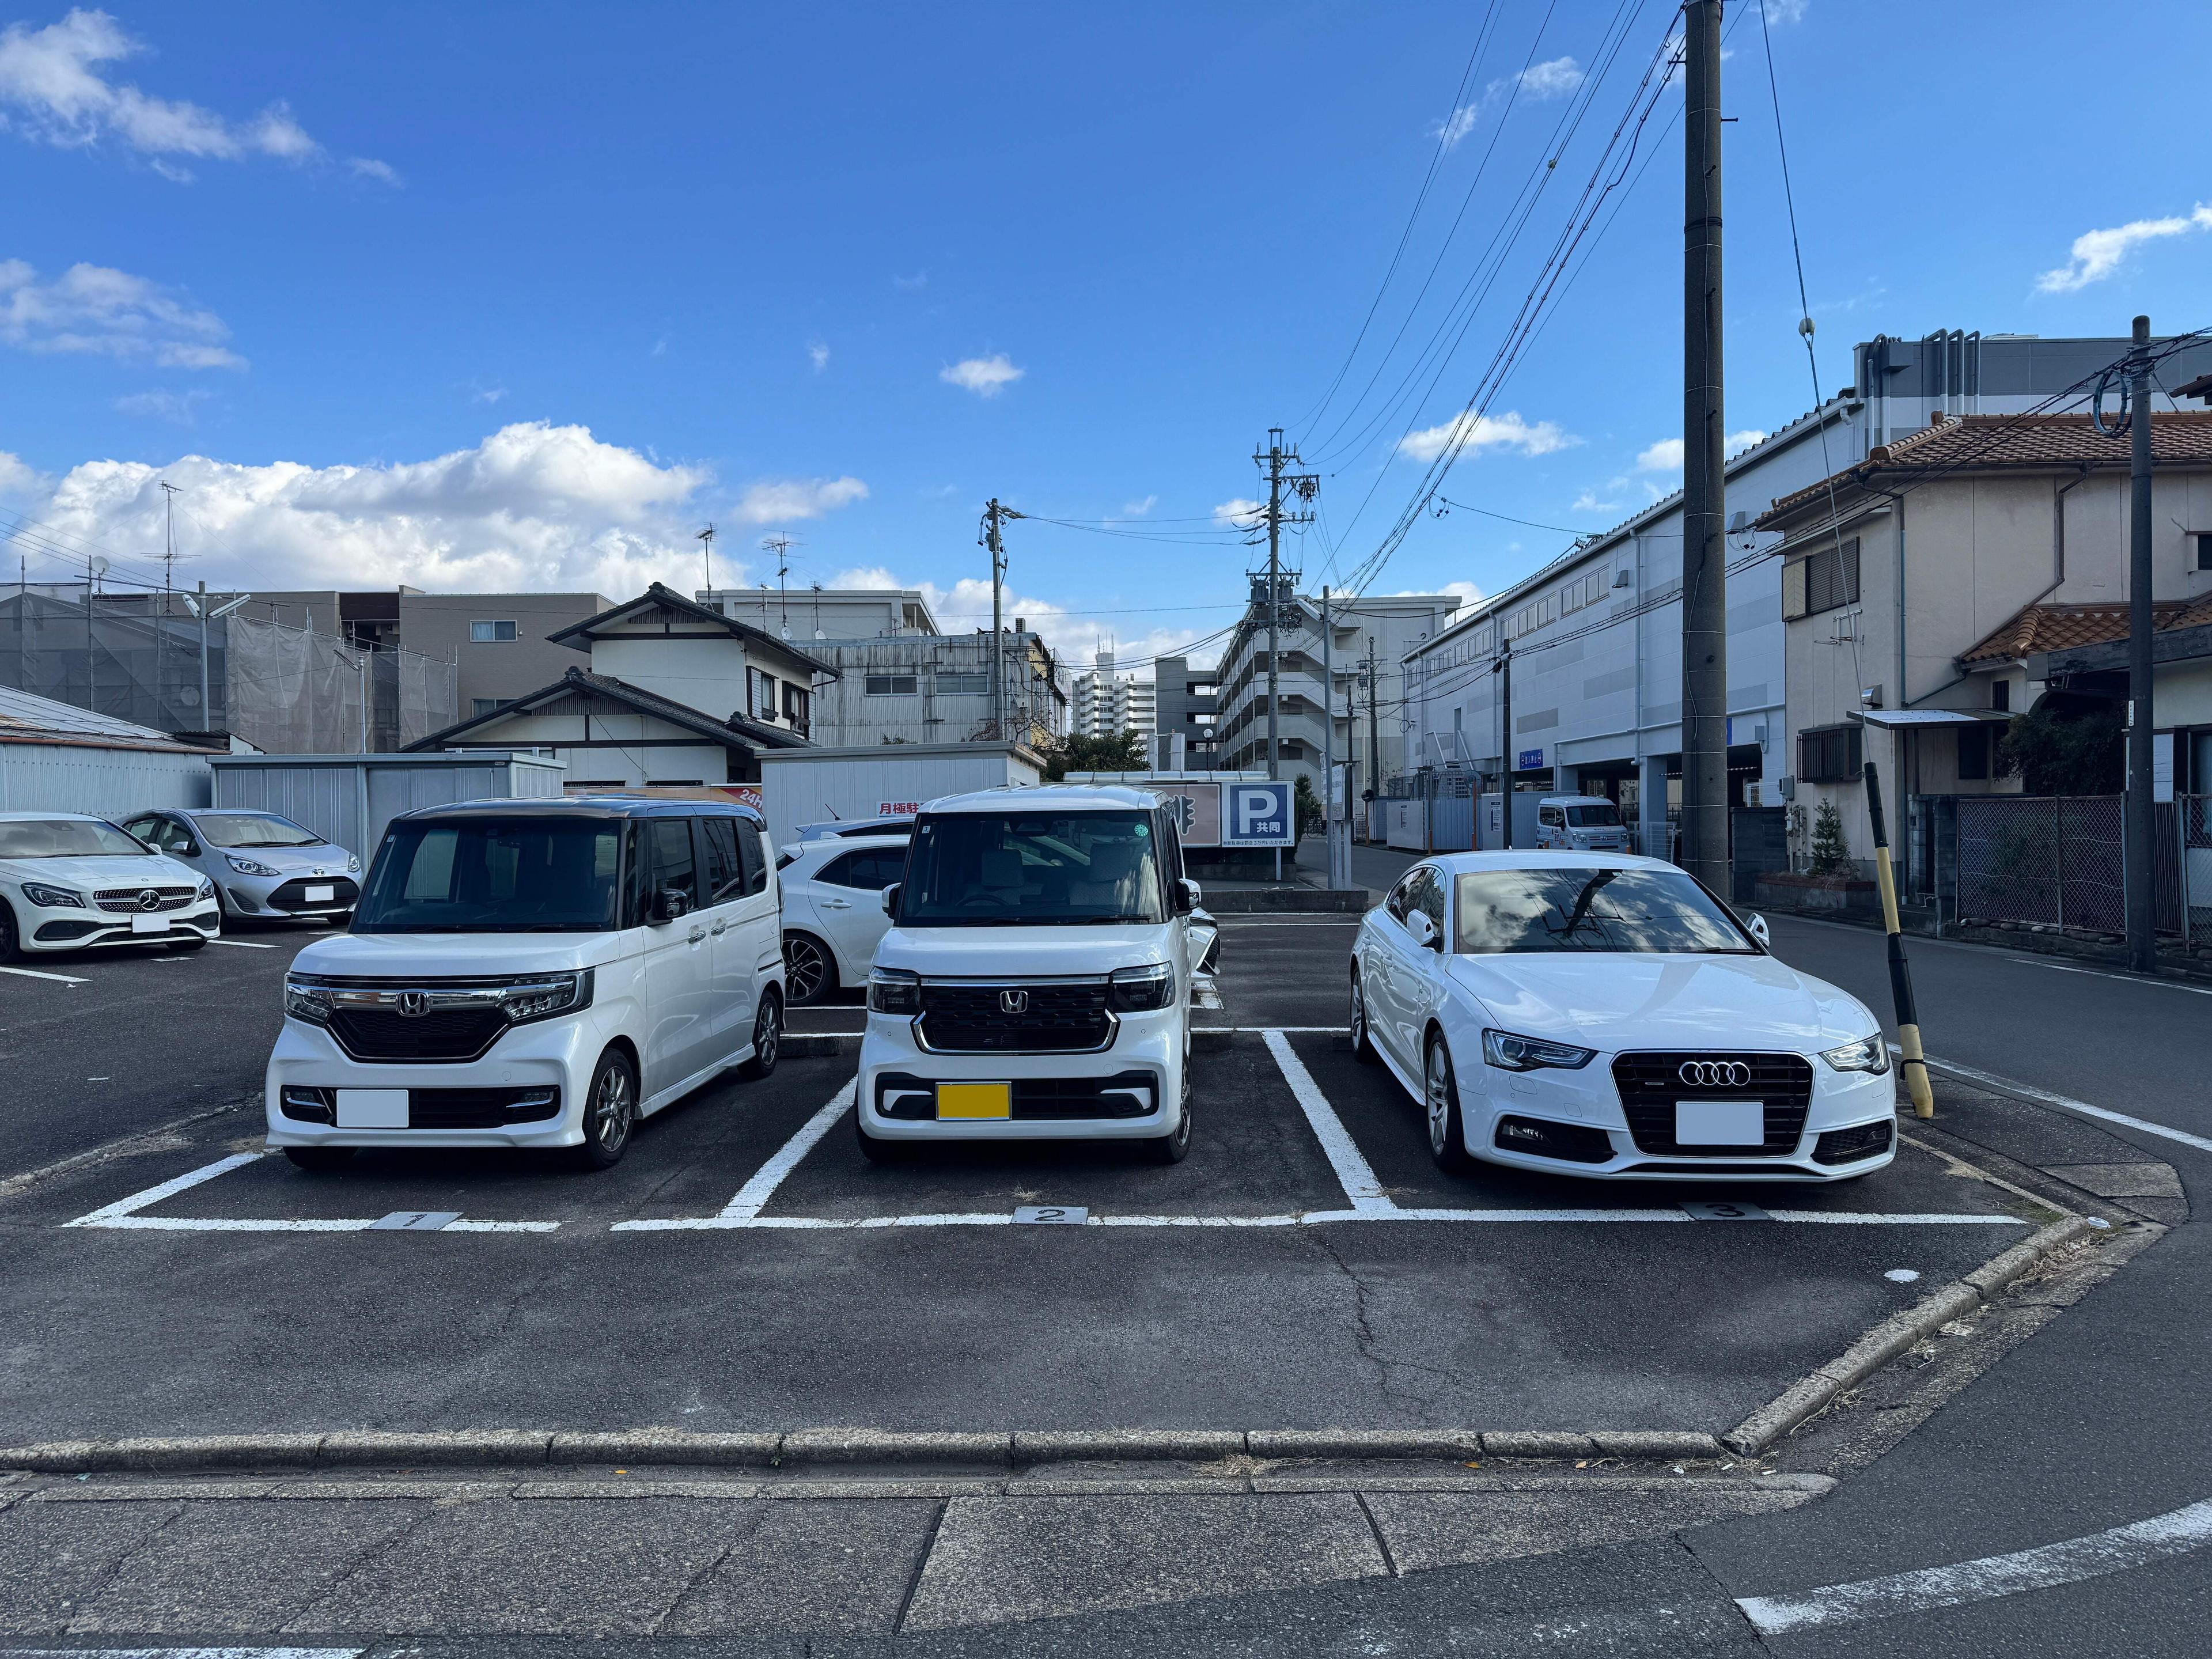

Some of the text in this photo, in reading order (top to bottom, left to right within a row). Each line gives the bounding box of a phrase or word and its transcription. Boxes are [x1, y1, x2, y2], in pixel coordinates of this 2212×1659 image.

[740, 789, 763, 808] 24H
[879, 802, 924, 814] 月極駐
[1238, 790, 1278, 834] P
[1256, 821, 1281, 833] 共同
[1034, 1209, 1066, 1221] 2
[1706, 1204, 1745, 1217] 3
[403, 1214, 427, 1226] 1
